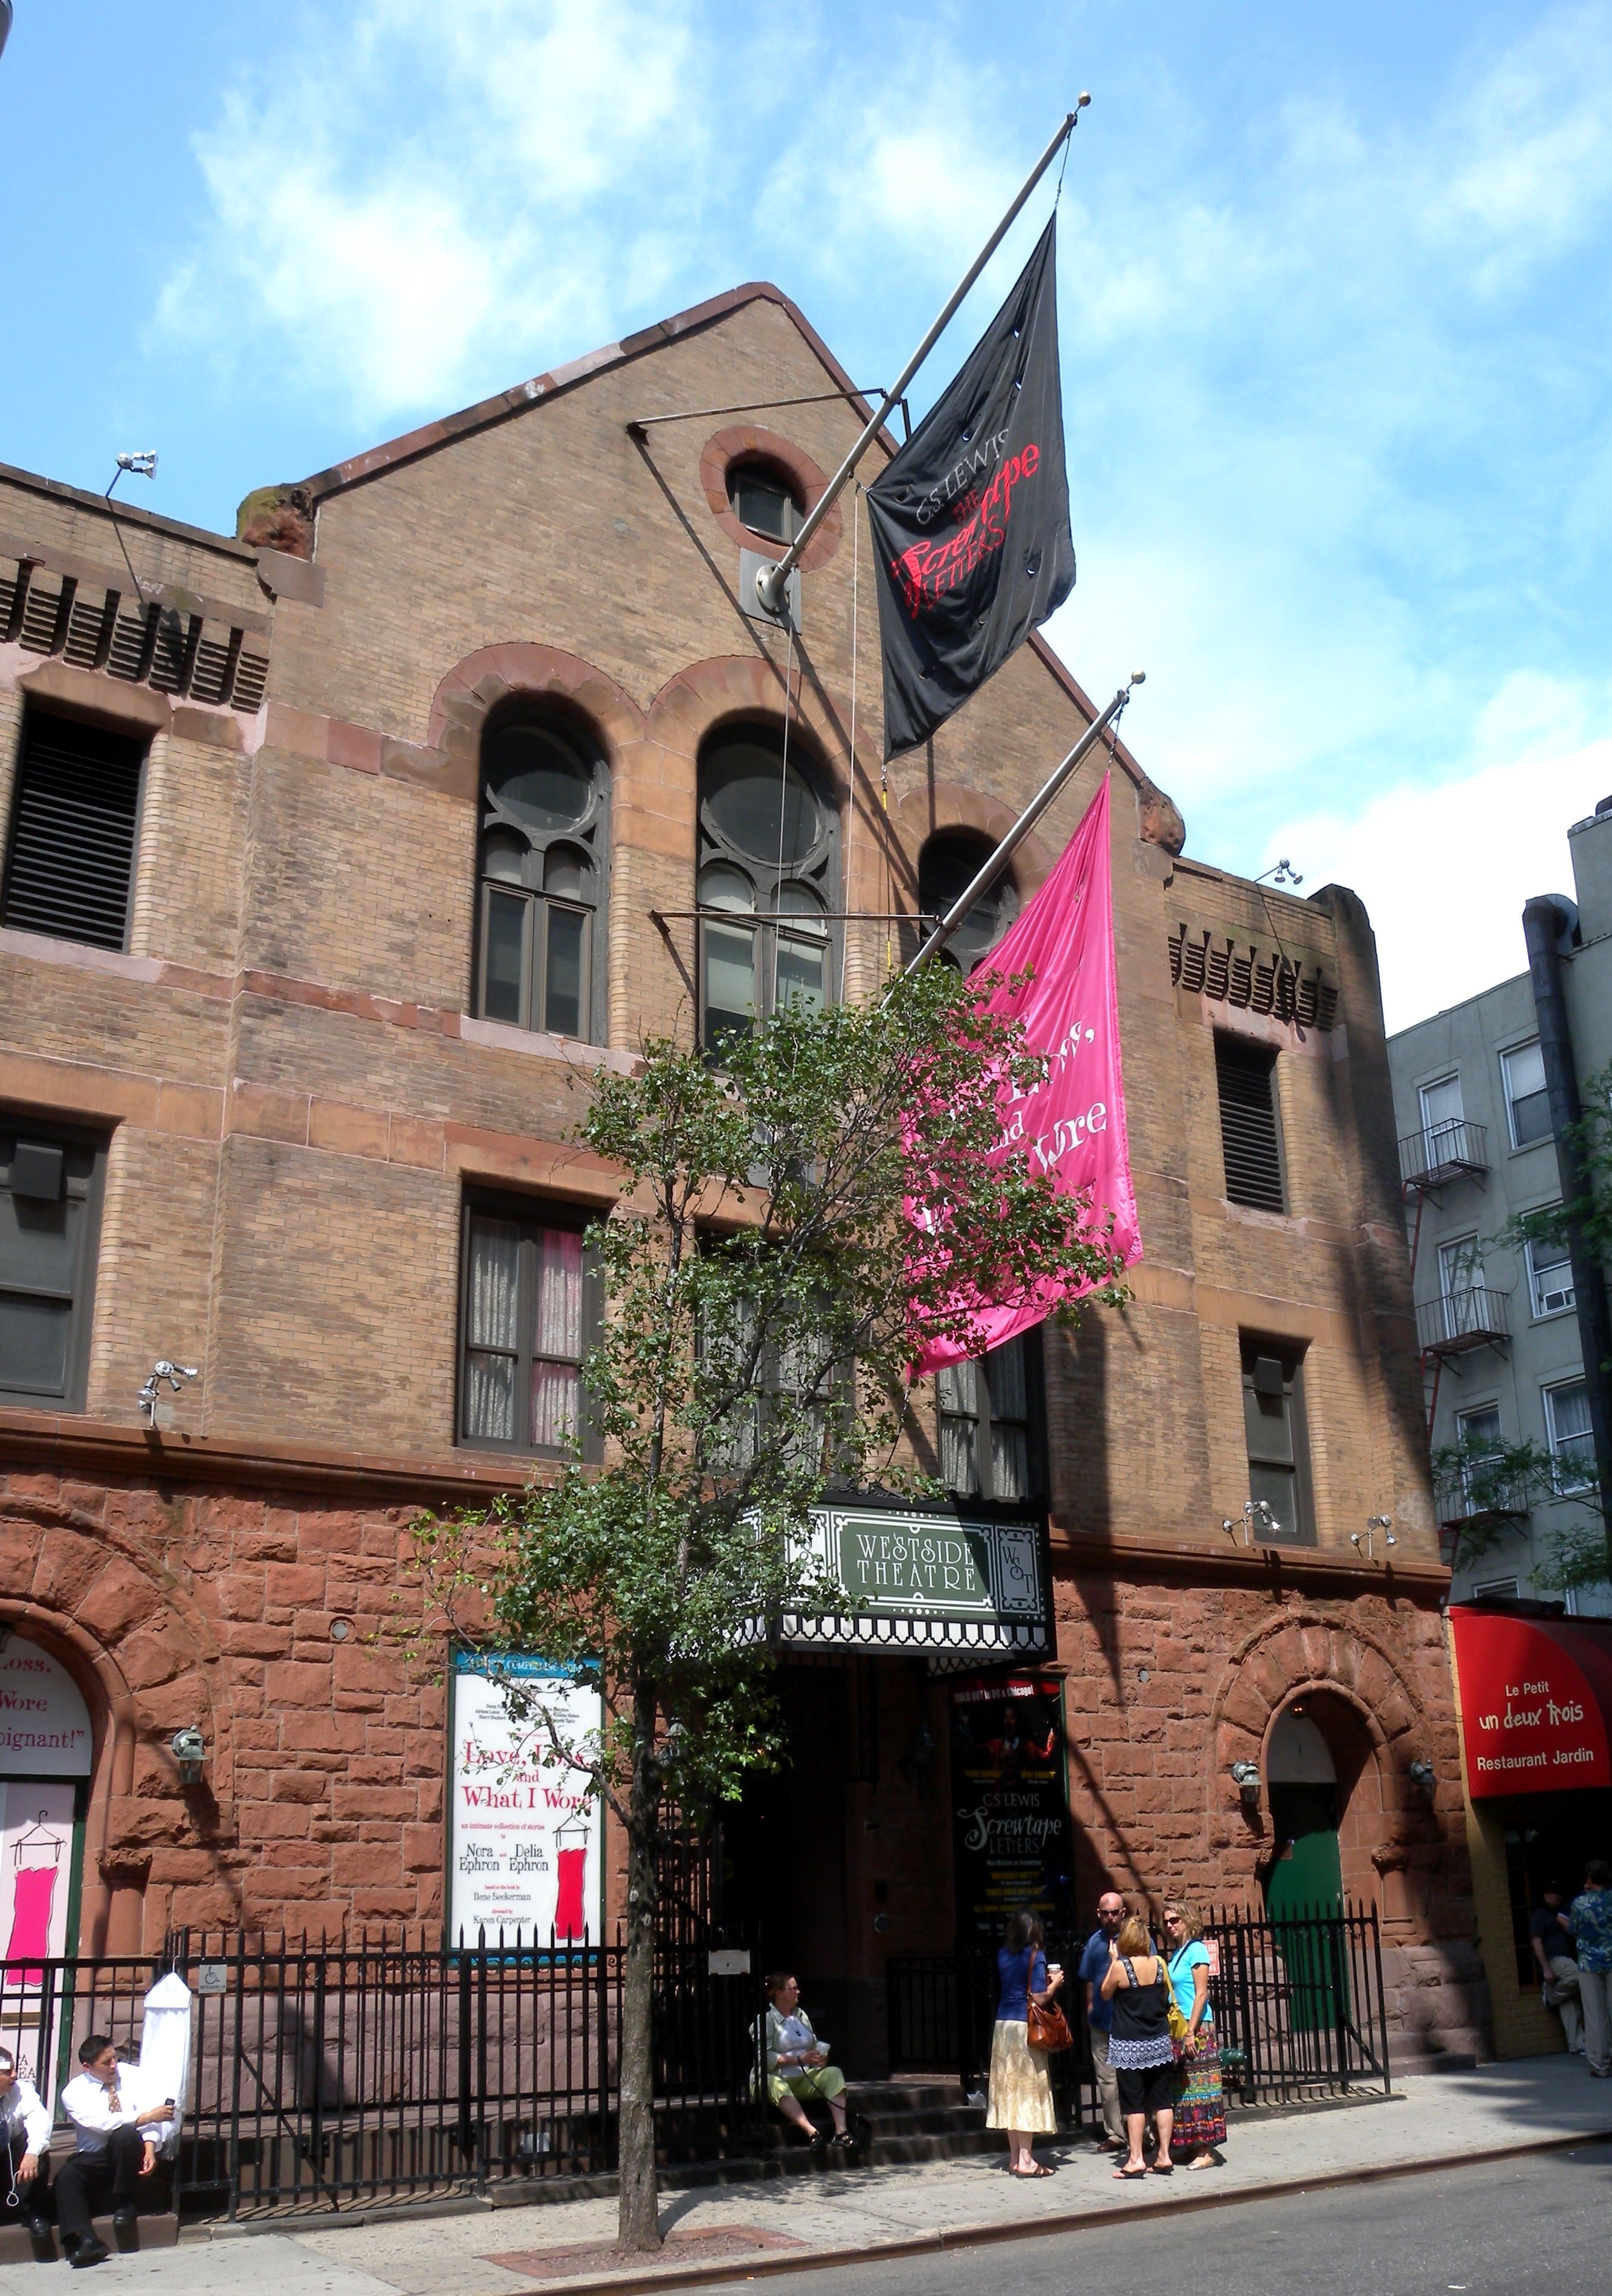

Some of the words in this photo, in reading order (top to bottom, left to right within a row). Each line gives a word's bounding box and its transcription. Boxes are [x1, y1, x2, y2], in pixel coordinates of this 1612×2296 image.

[890, 444, 1040, 618] Screape
[856, 1533, 975, 1566] WESTSIDE
[857, 1559, 976, 1592] THEATRE
[0, 1657, 51, 1674] oss.
[1006, 1684, 1034, 1698] Chicago!
[1505, 1685, 1519, 1697] Le
[1523, 1681, 1550, 1695] Petit
[1479, 1714, 1499, 1730] un
[1504, 1702, 1542, 1729] deux
[464, 1742, 528, 1766] Love,
[1477, 1752, 1547, 1771] Restaurant
[1552, 1748, 1594, 1765] Jardin
[516, 1770, 540, 1783] and
[461, 1786, 522, 1809] What
[527, 1788, 537, 1808] I
[542, 1788, 592, 1809] Wore
[1004, 1793, 1040, 1807] LEWIS
[956, 1806, 1062, 1851] Screwtape
[467, 1843, 493, 1857] Nora
[515, 1844, 543, 1858] Delia
[989, 1837, 1040, 1855] LETTERS
[459, 1857, 500, 1874] Ephron
[509, 1857, 549, 1874] Ephron
[473, 1892, 491, 1901] Ilene
[493, 1892, 531, 1901] Beckerman
[473, 1915, 494, 1924] Karen
[496, 1915, 532, 1925] Carpenter
